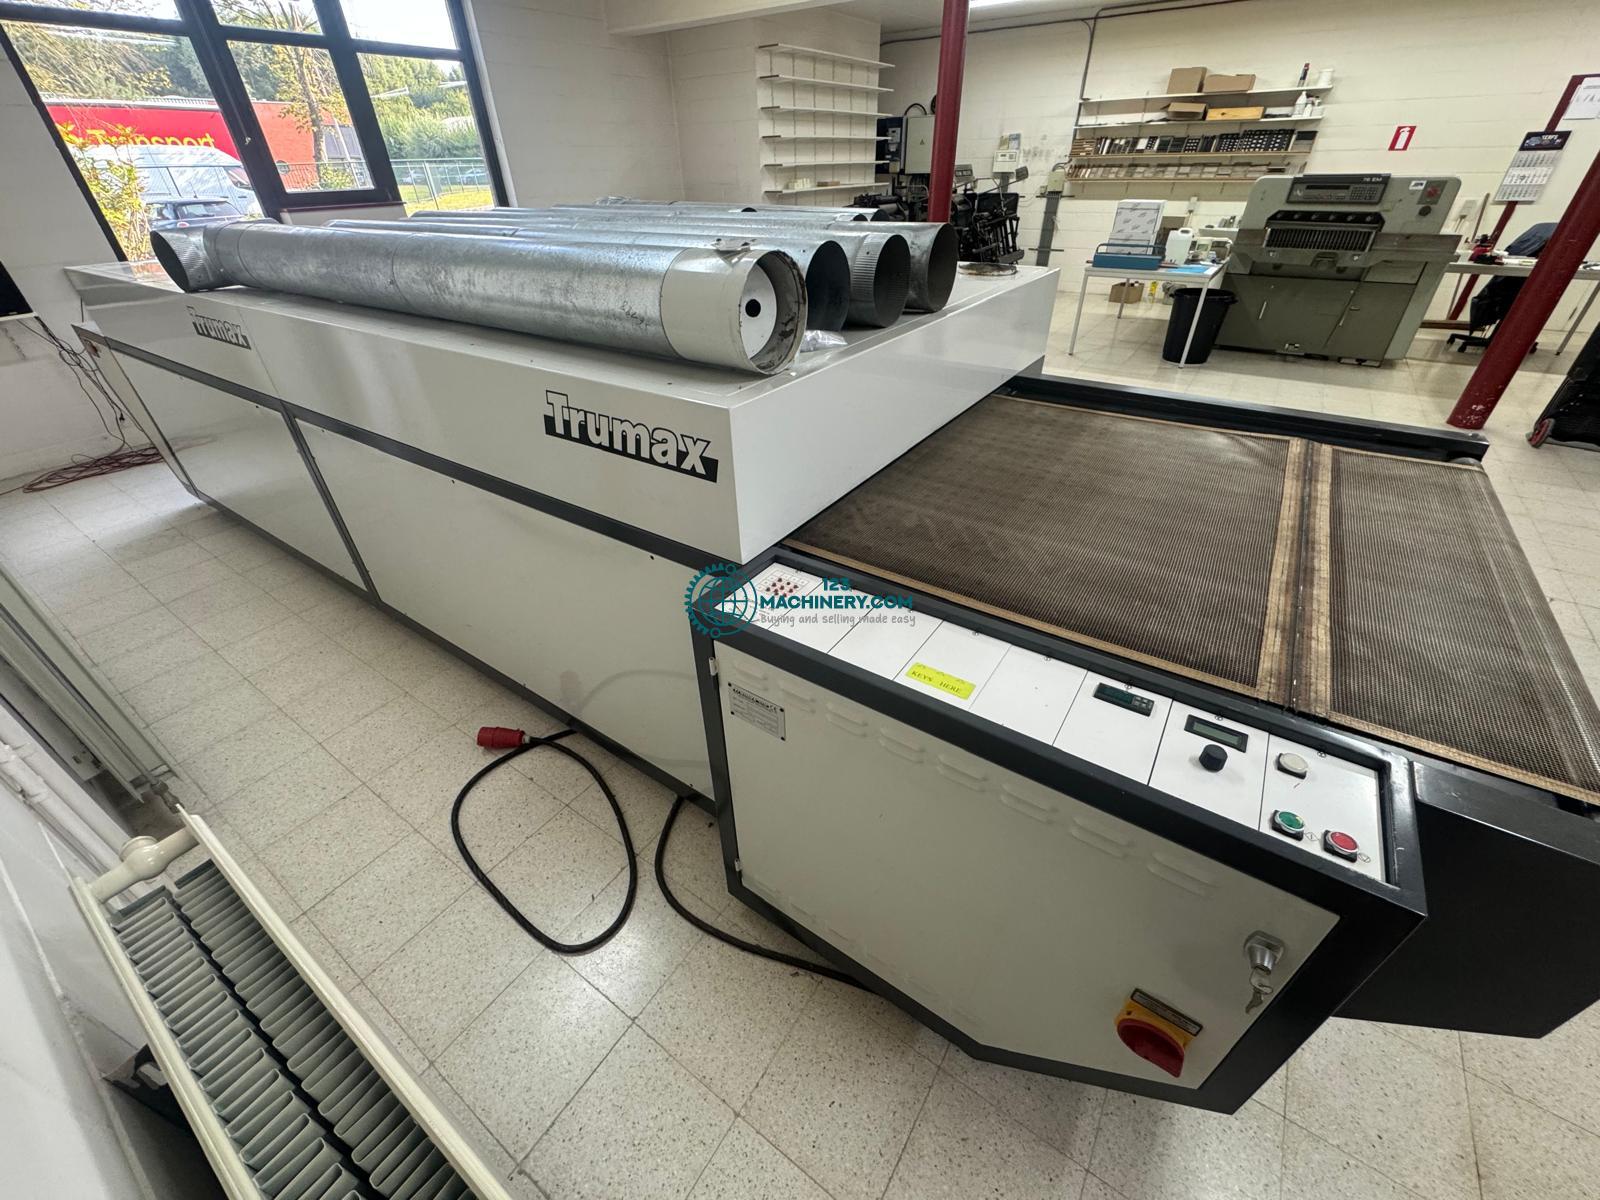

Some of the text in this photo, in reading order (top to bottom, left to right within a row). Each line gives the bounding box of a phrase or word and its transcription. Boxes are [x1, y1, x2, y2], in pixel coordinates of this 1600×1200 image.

[544, 390, 718, 483] Trumax
[910, 670, 961, 694] KEYS HERE
